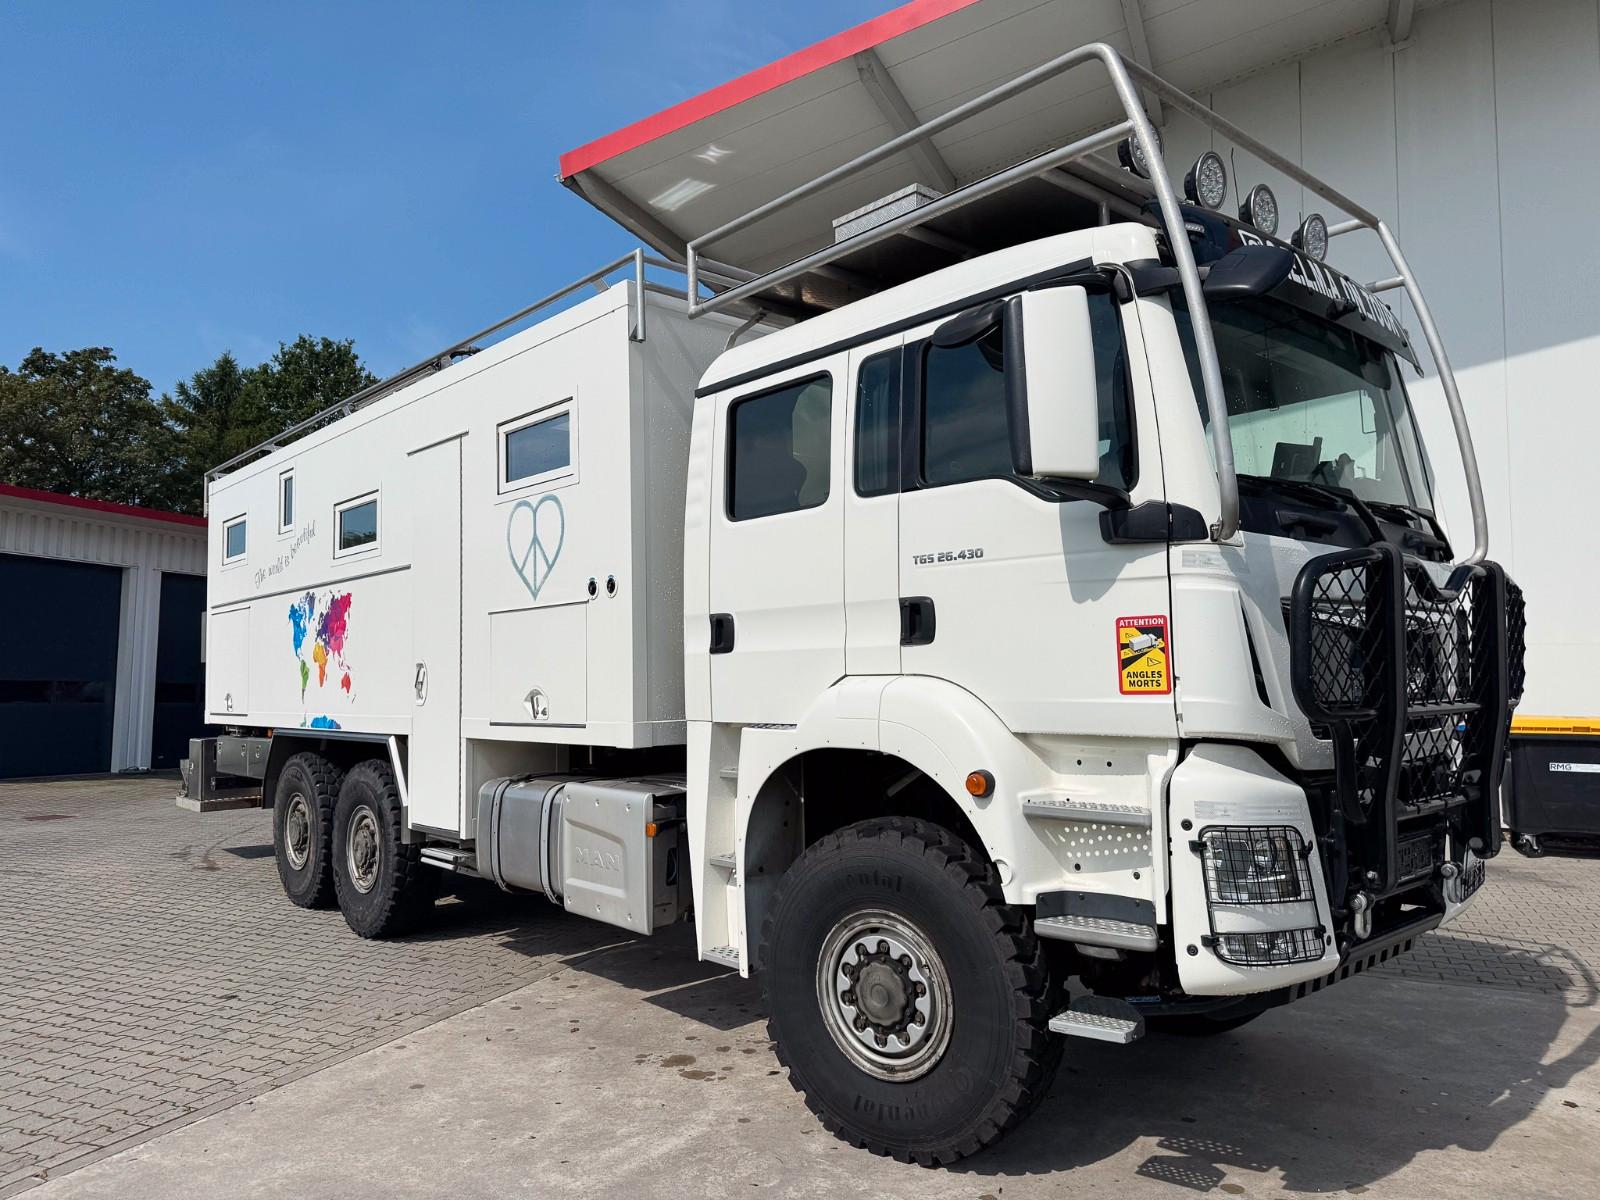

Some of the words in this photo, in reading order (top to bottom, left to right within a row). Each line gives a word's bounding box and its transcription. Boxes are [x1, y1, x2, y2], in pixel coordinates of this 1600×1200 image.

[937, 547, 984, 562] 26.430
[1119, 617, 1164, 627] ATTENTION
[1126, 670, 1162, 679] ANGLES
[1128, 679, 1161, 687] MORTS
[1550, 763, 1572, 771] RMG
[575, 846, 620, 872] MAN
